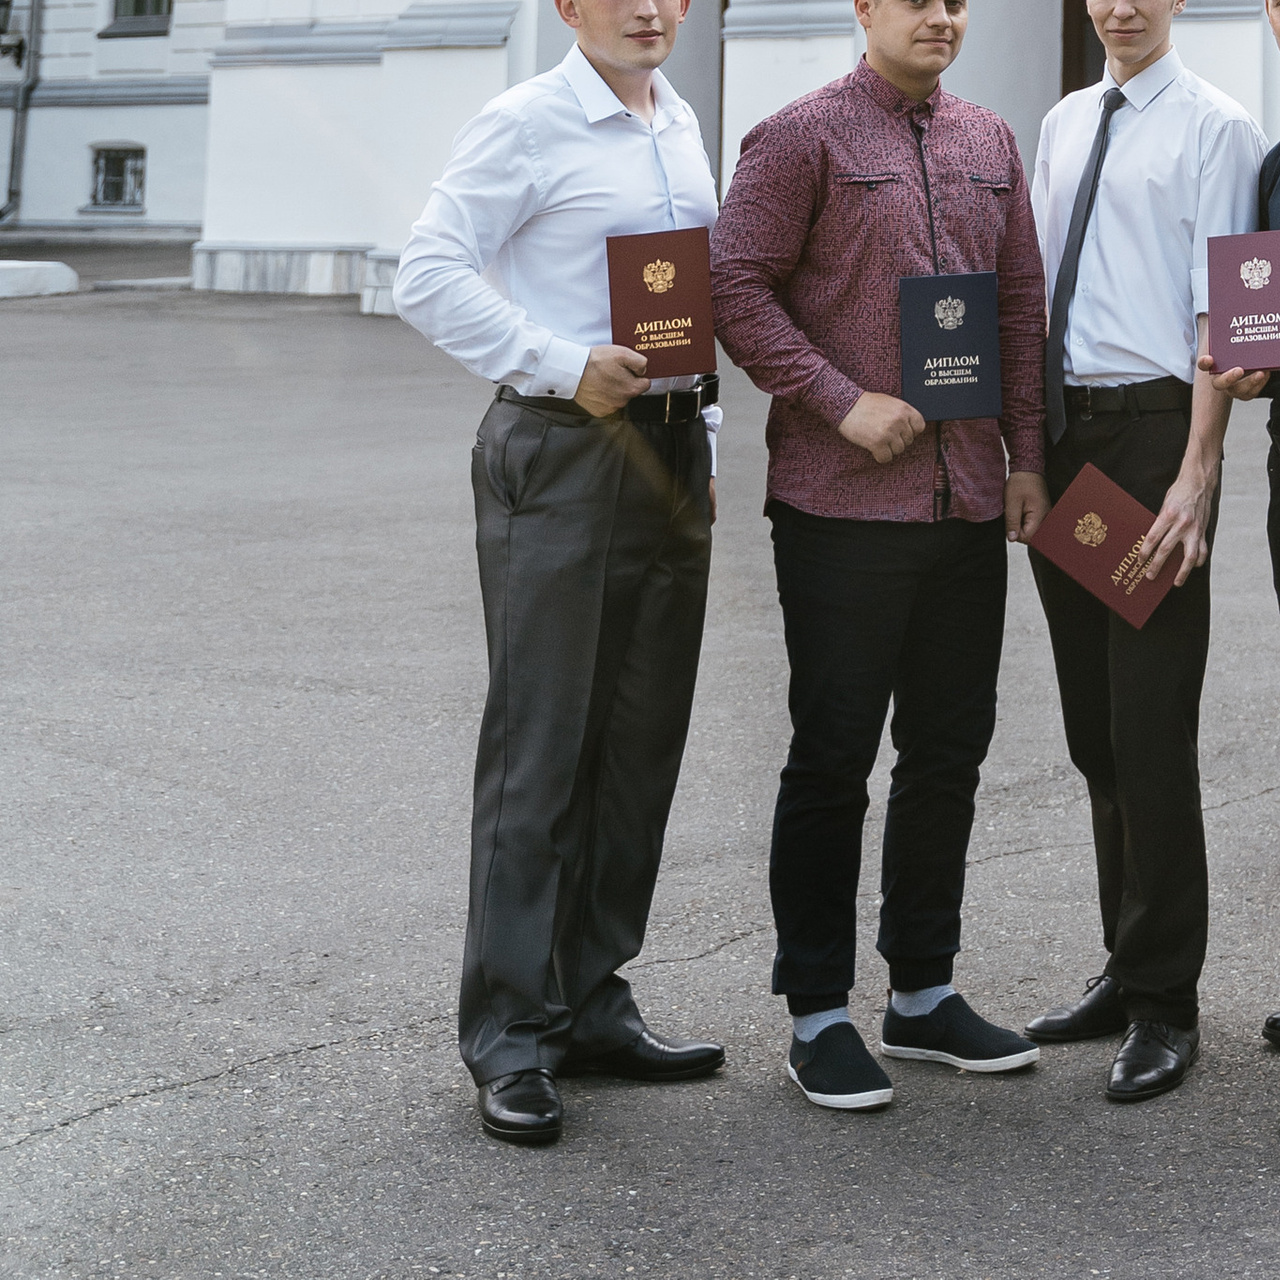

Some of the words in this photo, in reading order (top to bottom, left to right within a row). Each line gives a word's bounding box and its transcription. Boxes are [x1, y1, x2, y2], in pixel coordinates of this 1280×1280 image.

[634, 317, 692, 335] ДИПЛОМ
[1245, 325, 1278, 335] ВЫСШЕМ
[650, 331, 684, 341] ВЫСШЕМ
[635, 338, 691, 351] ОБРАЗОВАНИИ
[924, 355, 980, 370] ДИПЛОМ
[938, 368, 972, 378] ВЫСШЕМ
[924, 377, 978, 386] ОБРАЗОВАНИИ
